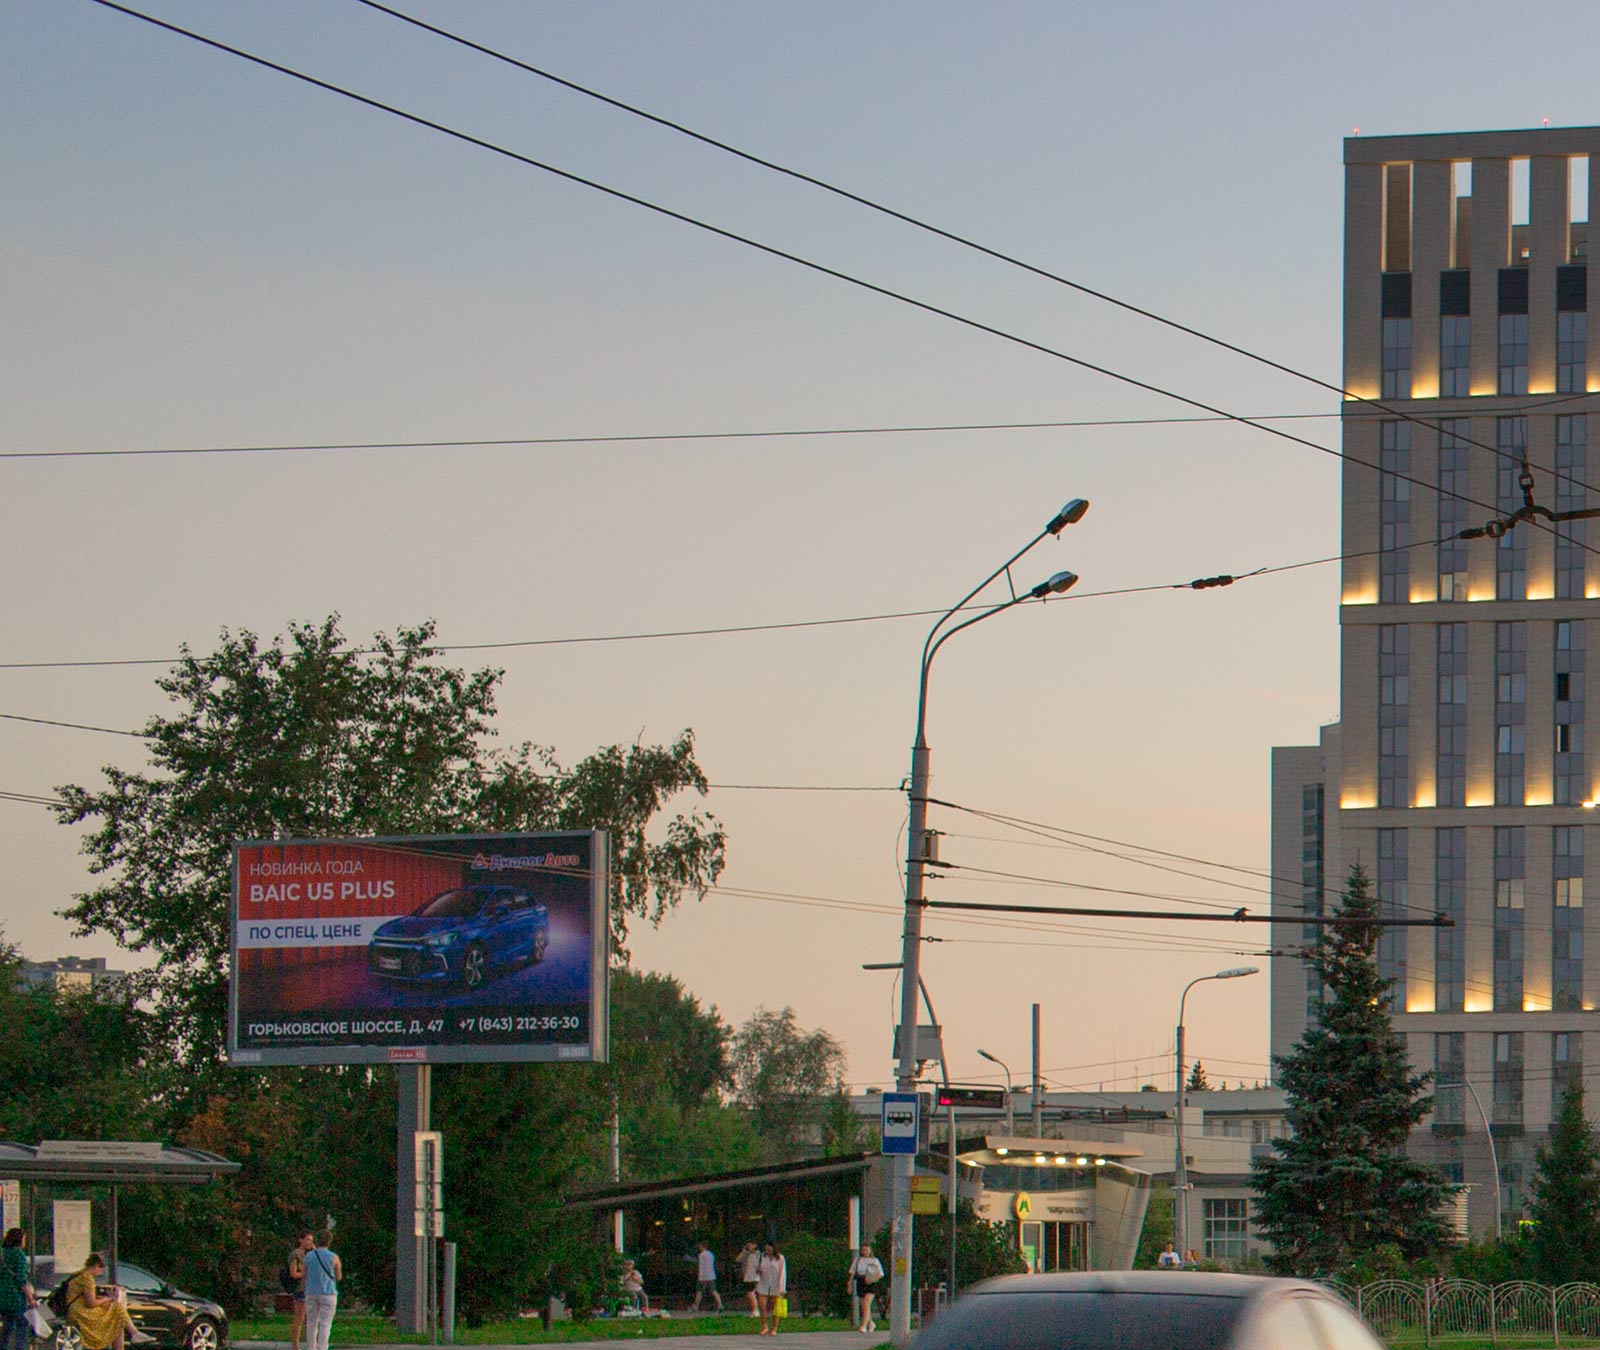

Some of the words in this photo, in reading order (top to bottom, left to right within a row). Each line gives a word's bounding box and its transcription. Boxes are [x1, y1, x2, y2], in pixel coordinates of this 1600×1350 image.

[250, 861, 322, 877] НОВИНКА
[325, 860, 364, 876] ГОДА
[250, 883, 300, 903] BAIC
[307, 882, 335, 901] U5
[341, 880, 396, 900] PLUS
[250, 926, 271, 940] ПО
[274, 924, 319, 941] СПЕЦ.
[322, 923, 362, 940] ЦЕНЕ
[248, 1021, 348, 1037] ГОРЬКОВСКОЕ
[351, 1020, 406, 1036] ШОССЕ,
[409, 1020, 424, 1037] Д.
[427, 1019, 444, 1033] 47
[459, 1018, 475, 1032] +7
[478, 1016, 514, 1033] (843)
[516, 1016, 579, 1031] 212-36-30
[4, 1193, 19, 1202] 177
